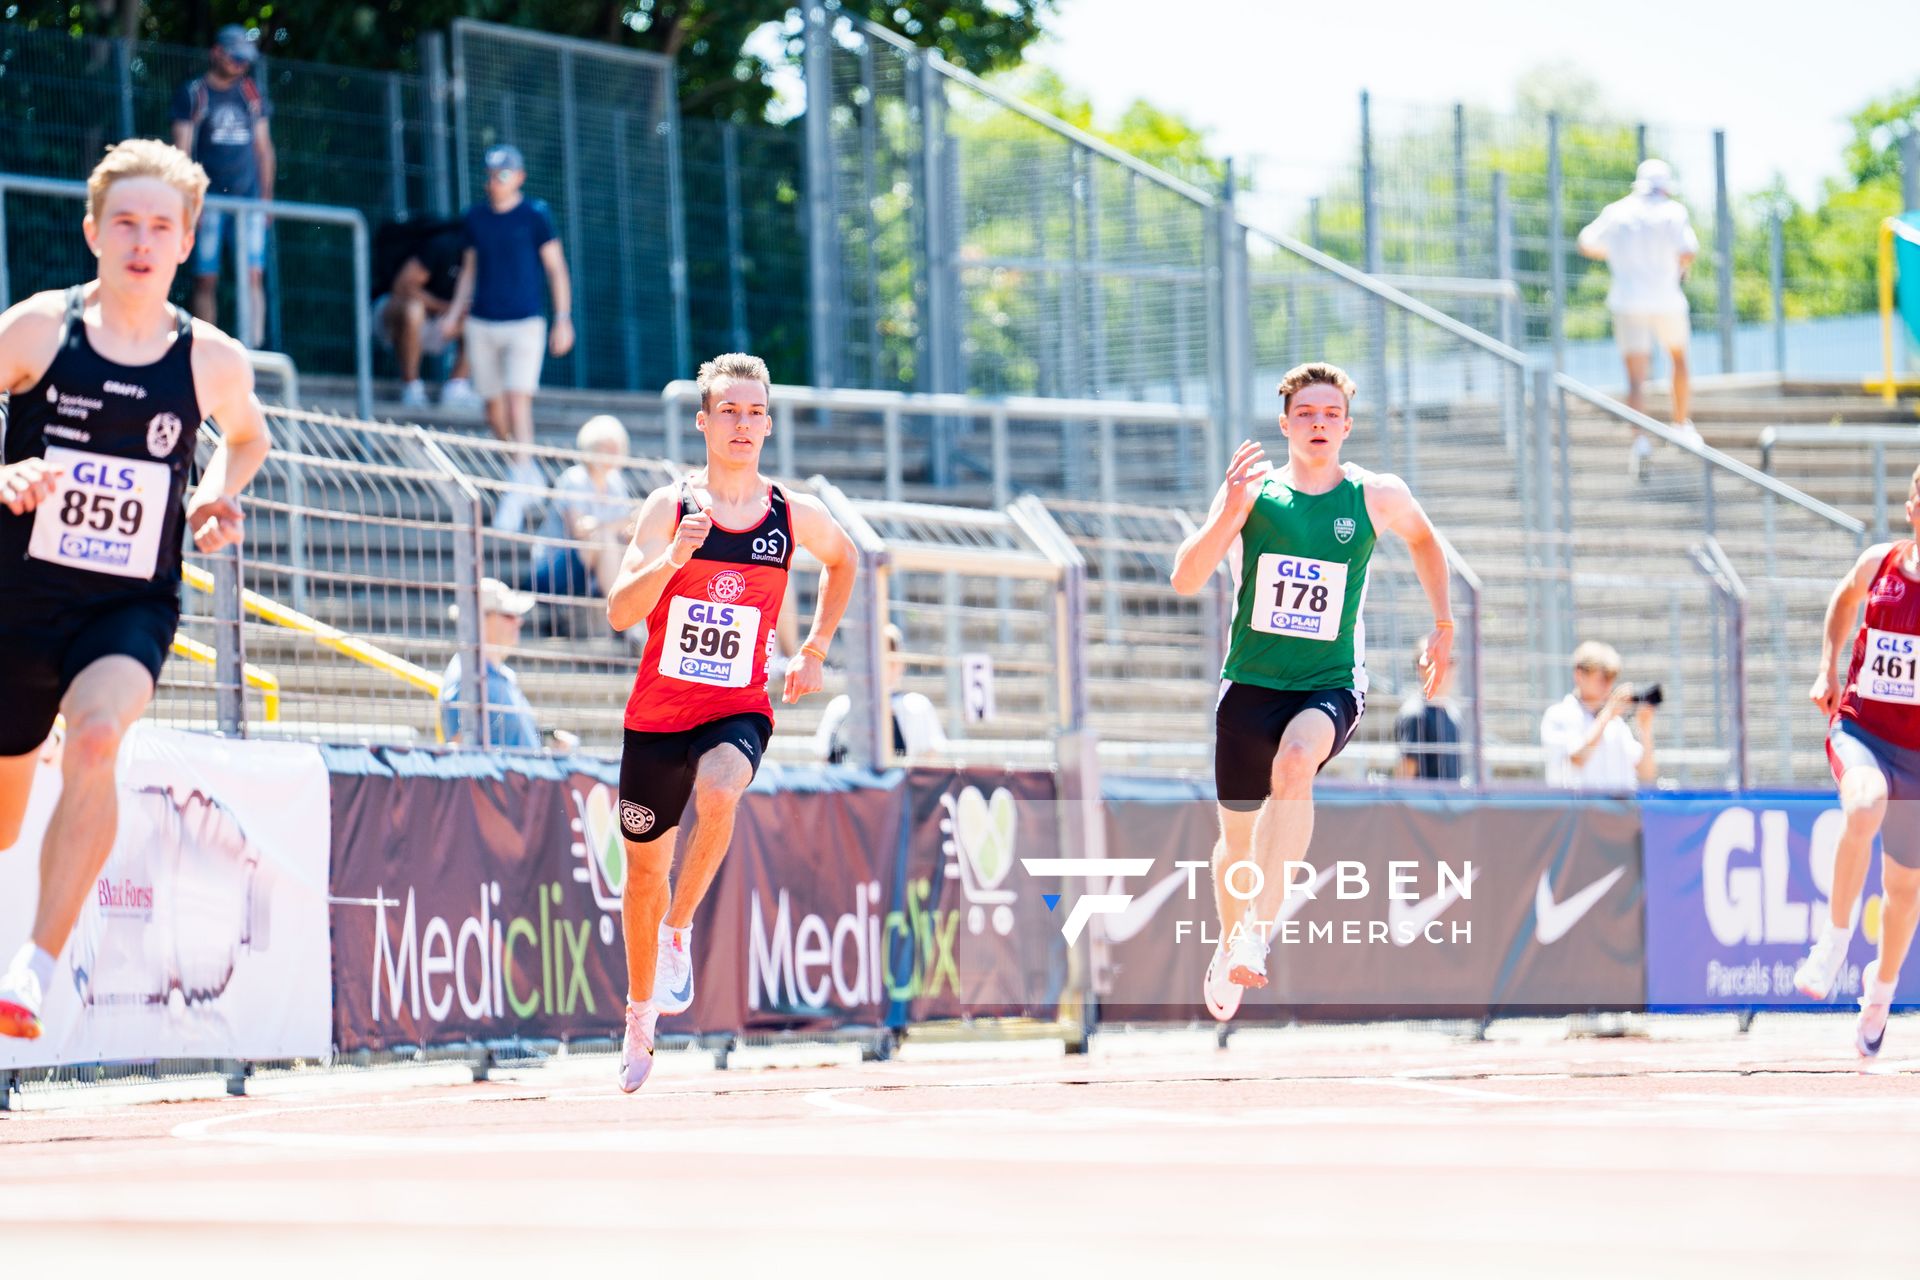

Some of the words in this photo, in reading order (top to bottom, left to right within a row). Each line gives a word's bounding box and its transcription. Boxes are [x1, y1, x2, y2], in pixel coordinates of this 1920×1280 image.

[60, 490, 142, 536] 859
[752, 537, 778, 555] OS
[1272, 580, 1328, 612] 178
[680, 623, 741, 660] 596
[1871, 654, 1916, 681] 461
[371, 880, 597, 1022] Mediclix
[748, 876, 961, 1009] Mediclix
[1706, 957, 1769, 997] Parcels
